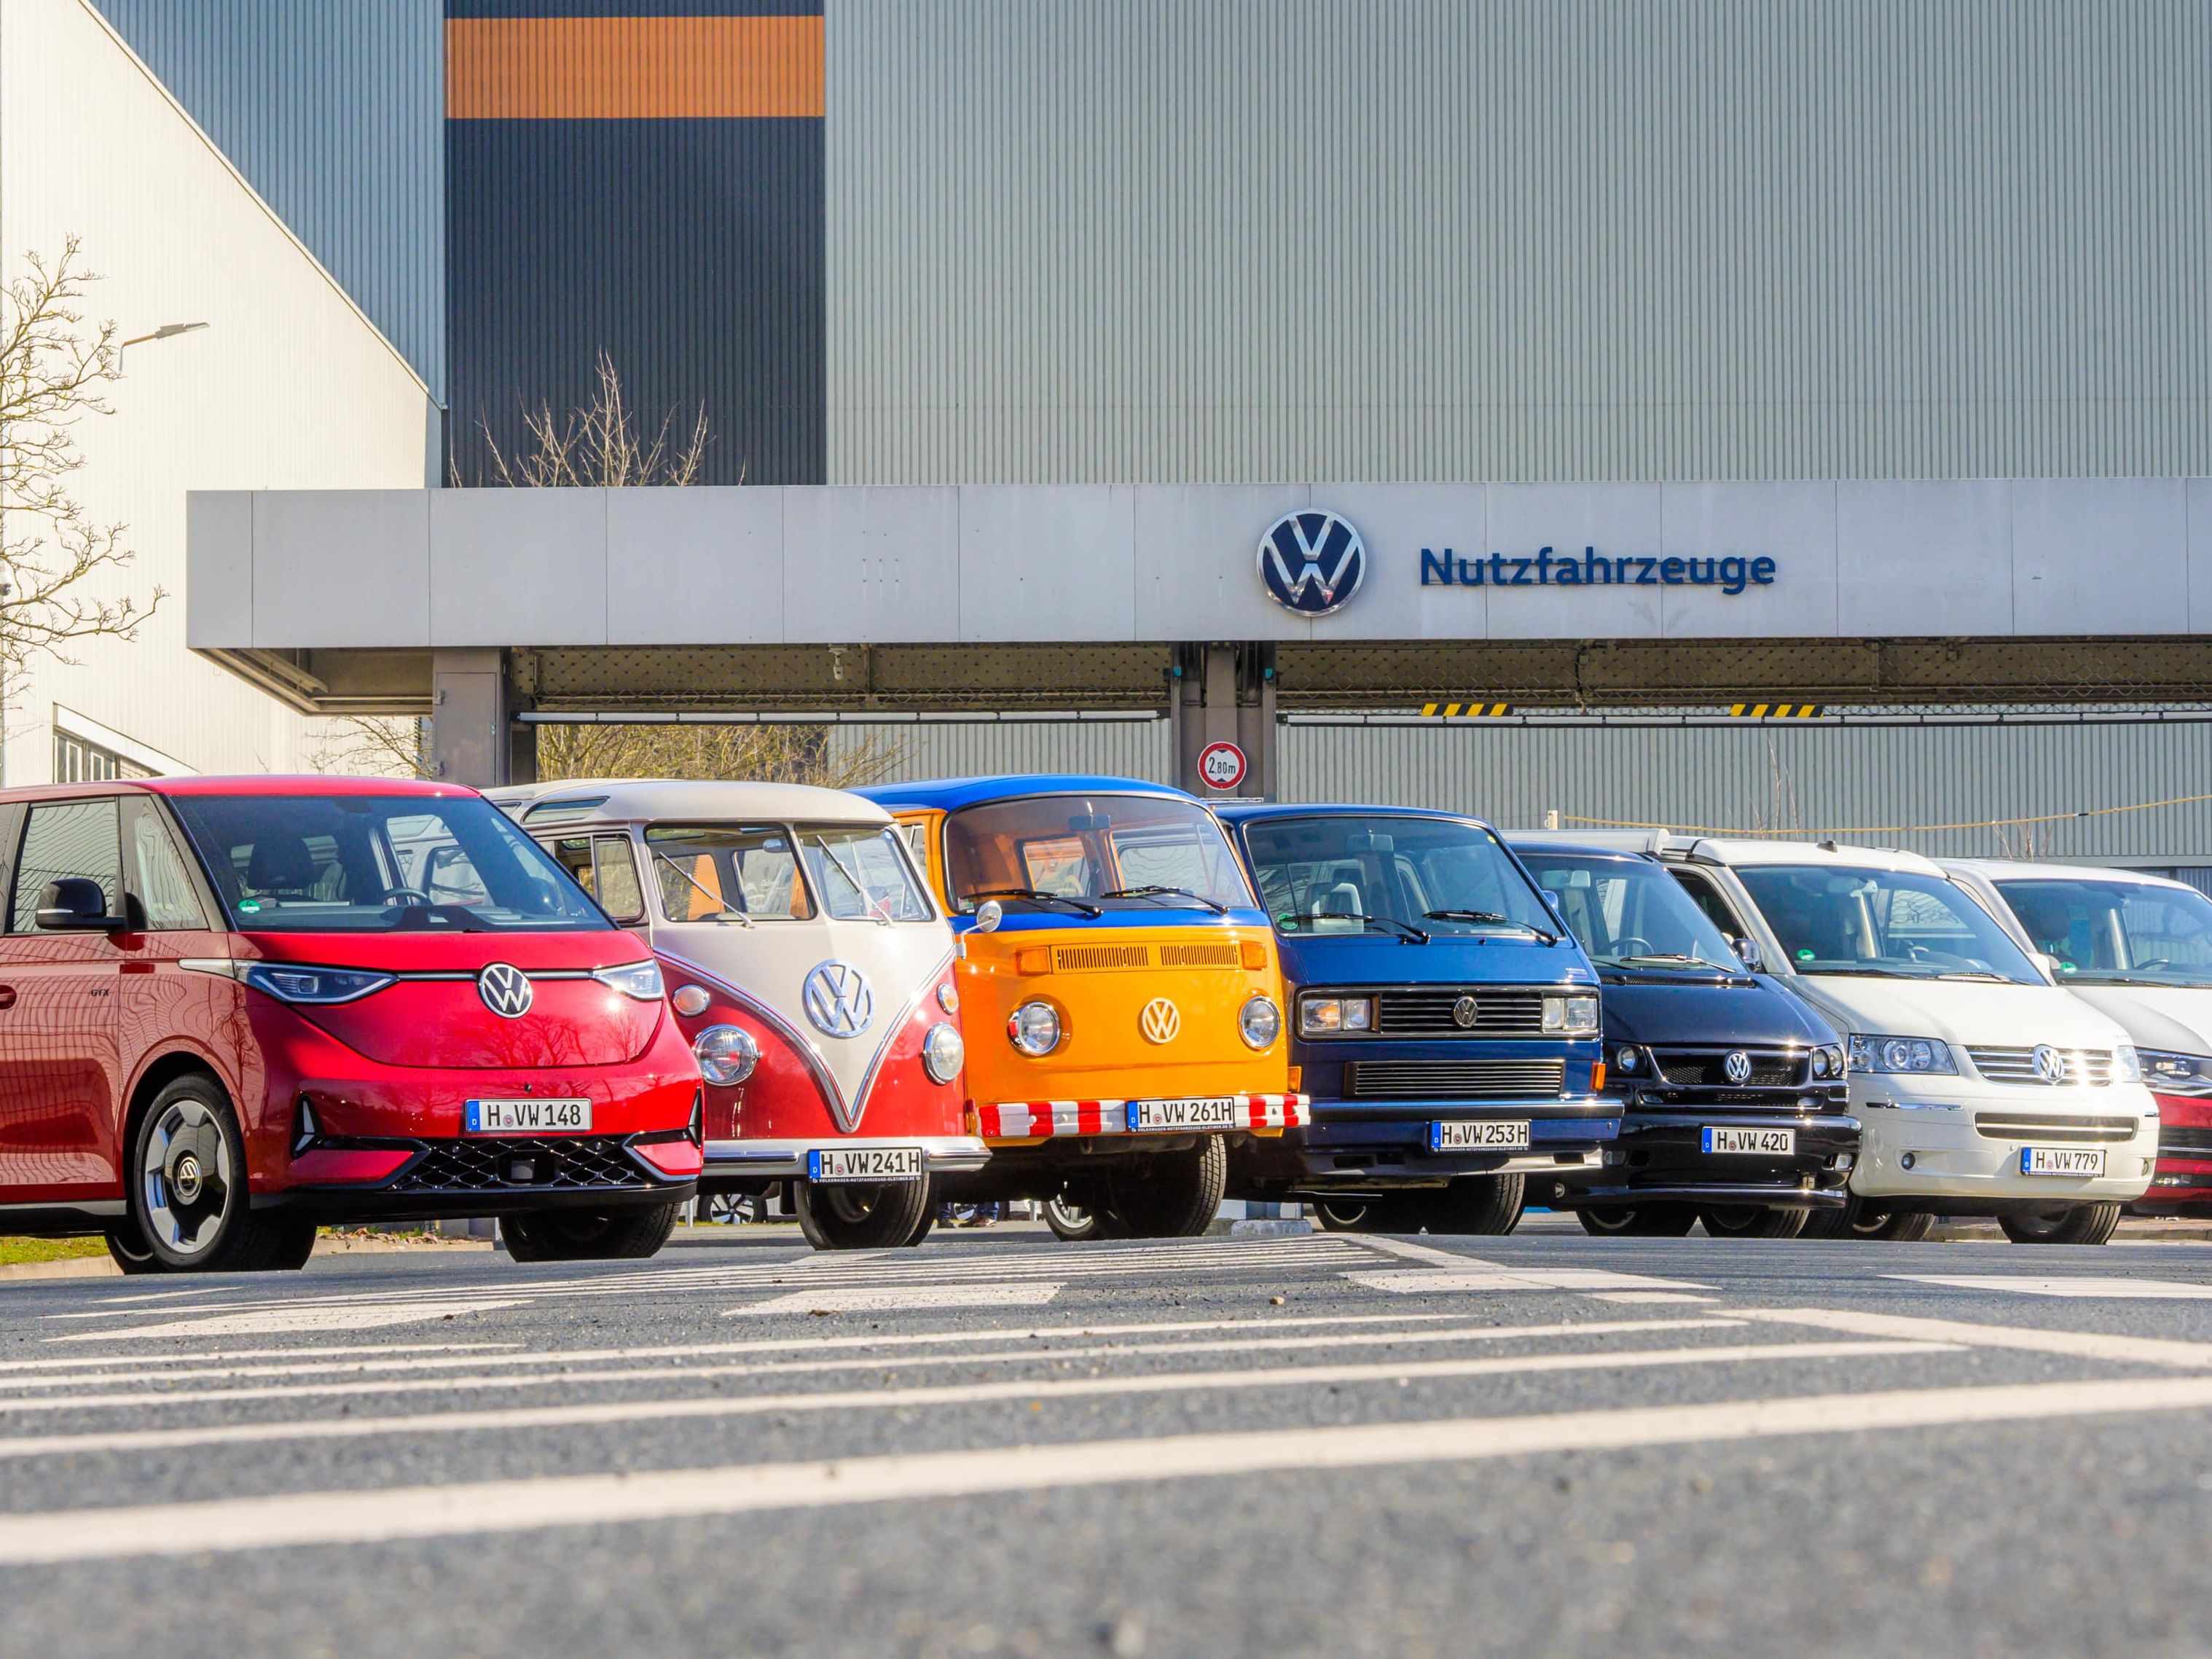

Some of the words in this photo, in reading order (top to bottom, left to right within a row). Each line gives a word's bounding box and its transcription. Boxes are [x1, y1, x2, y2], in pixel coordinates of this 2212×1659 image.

[1258, 511, 1364, 611] VW
[1421, 546, 1776, 595] Nutzfahrzeuge
[91, 989, 109, 997] GTX
[482, 964, 532, 1017] VW
[804, 960, 875, 1038] VW
[1142, 997, 1180, 1043] VW
[1727, 1054, 1749, 1080] VW
